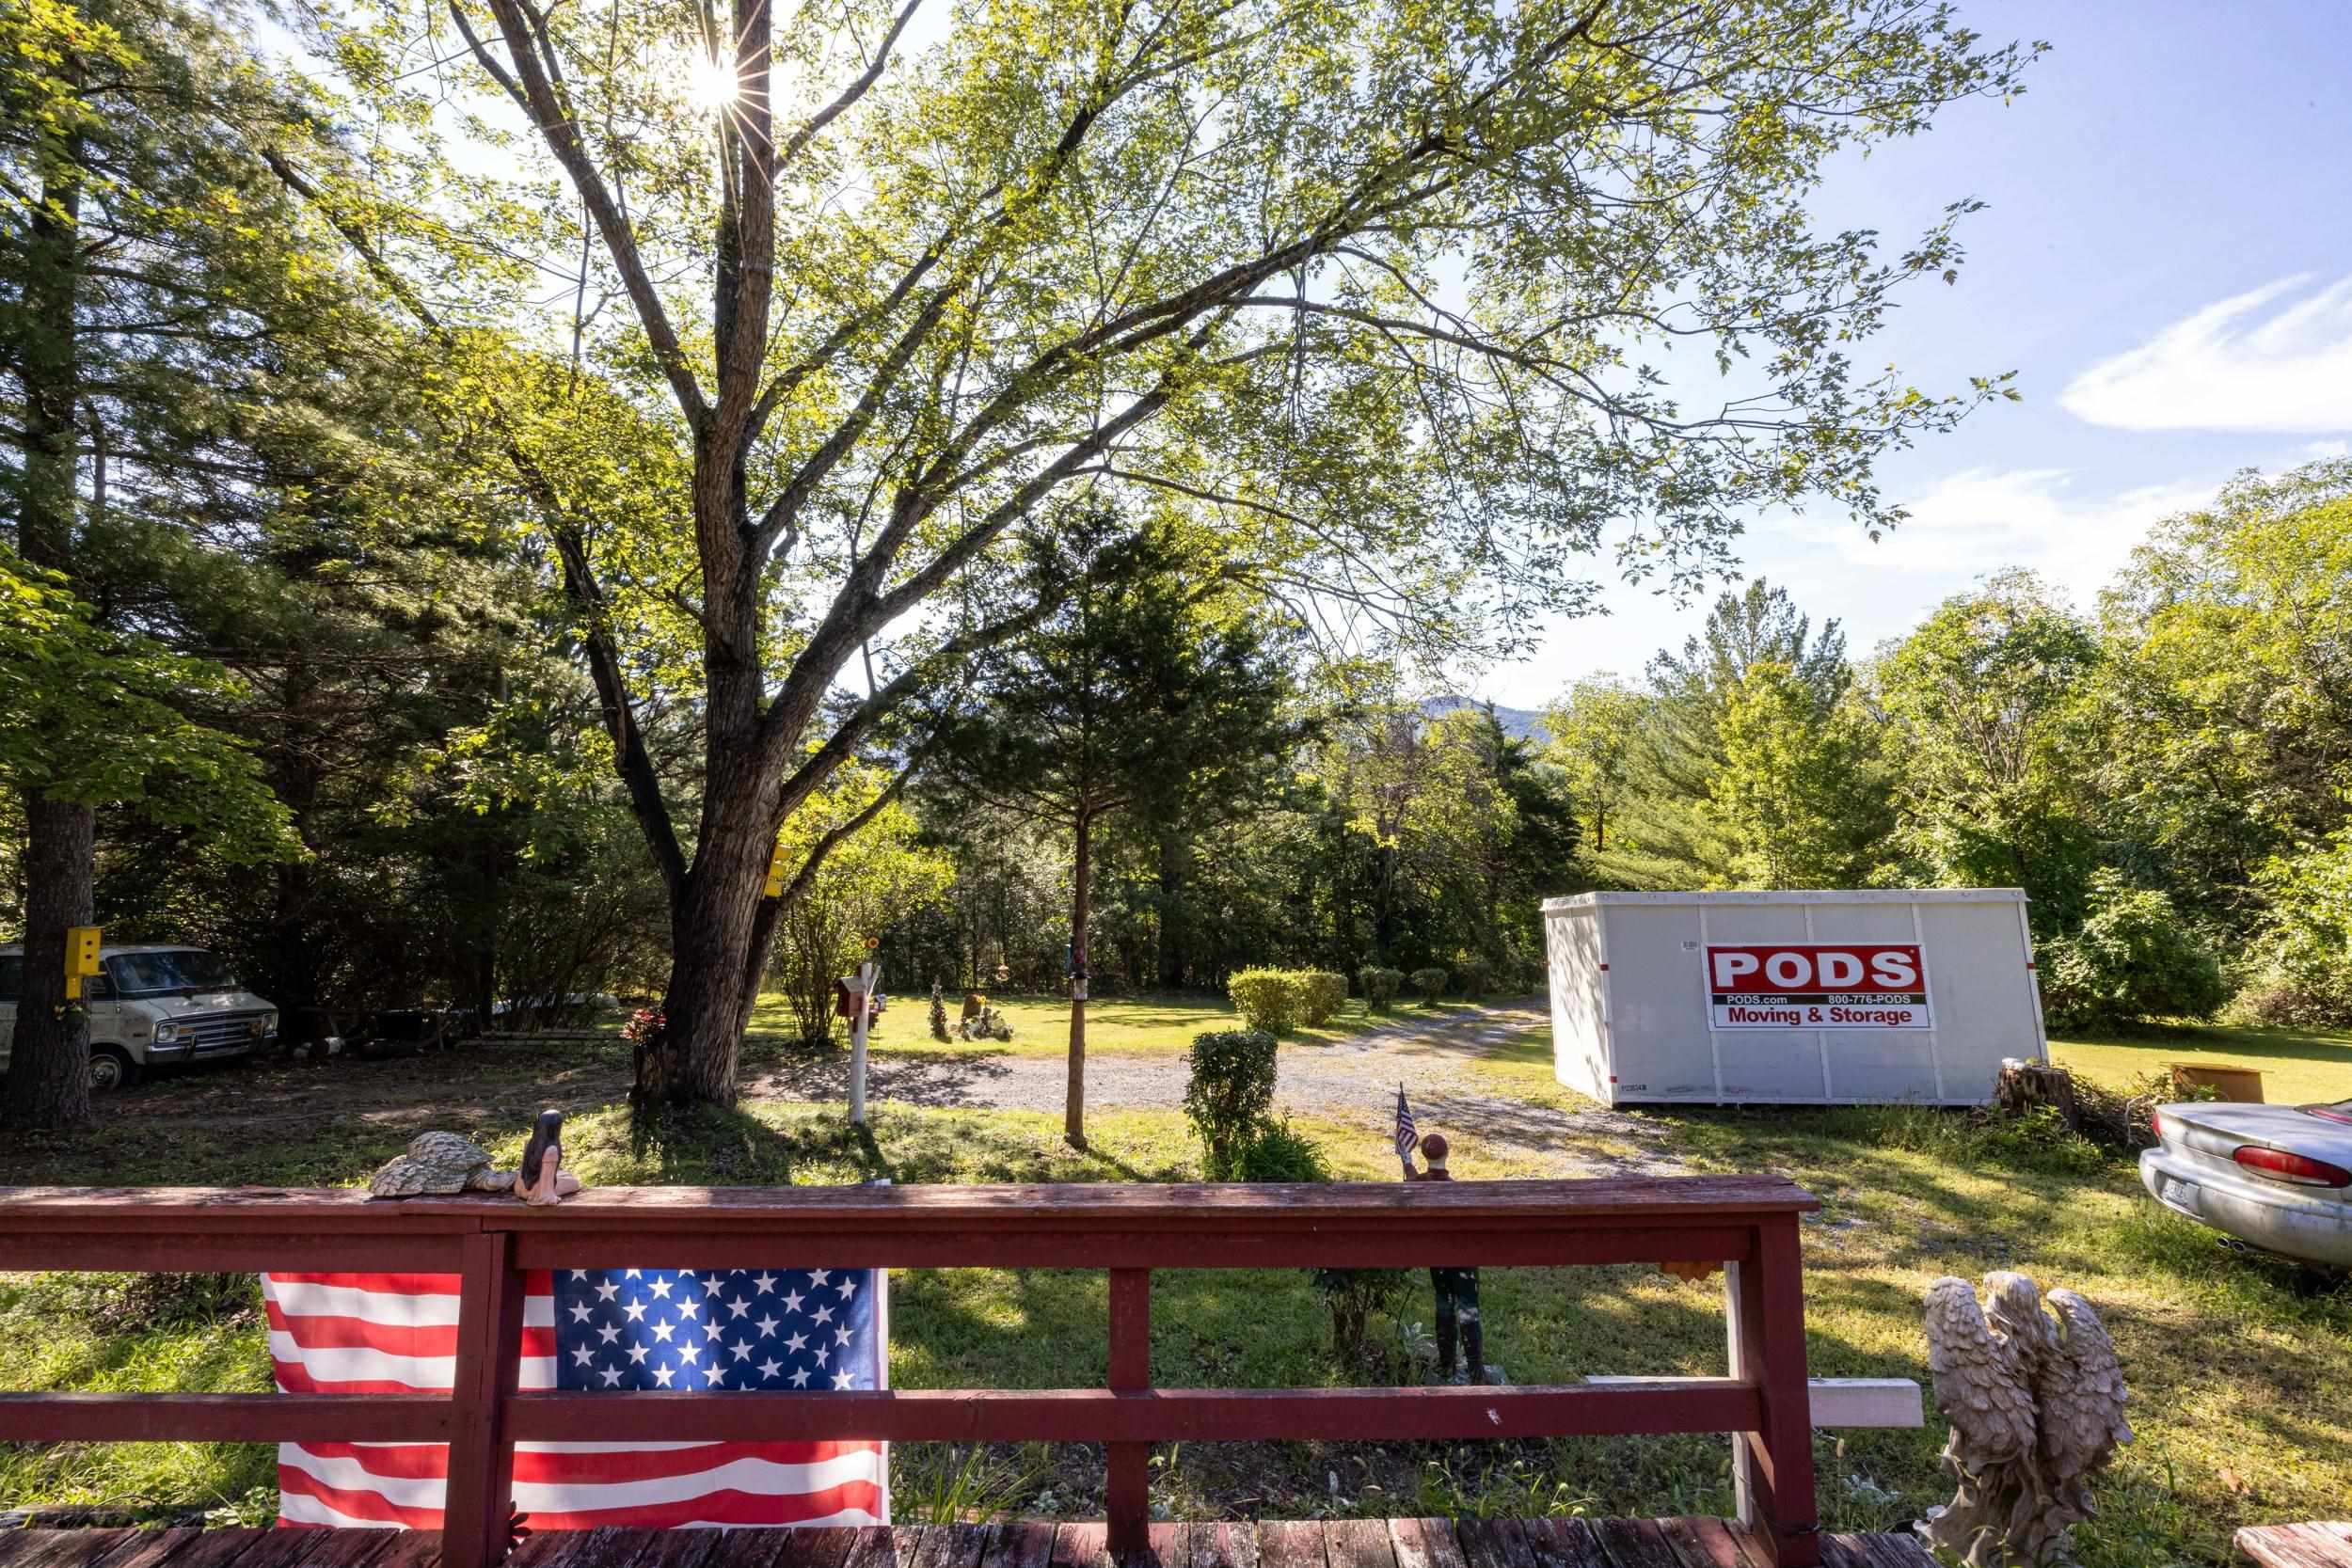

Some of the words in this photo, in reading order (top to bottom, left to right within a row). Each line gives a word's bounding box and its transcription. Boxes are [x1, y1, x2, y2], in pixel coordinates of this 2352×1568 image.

[1713, 952, 1916, 988] PODS
[1726, 995, 1788, 1005] PODS.com
[1828, 994, 1911, 1004] 800-776-PODS
[1728, 1007, 1801, 1025] Moving
[1807, 1007, 1823, 1022] &
[1830, 1006, 1912, 1025] Storage
